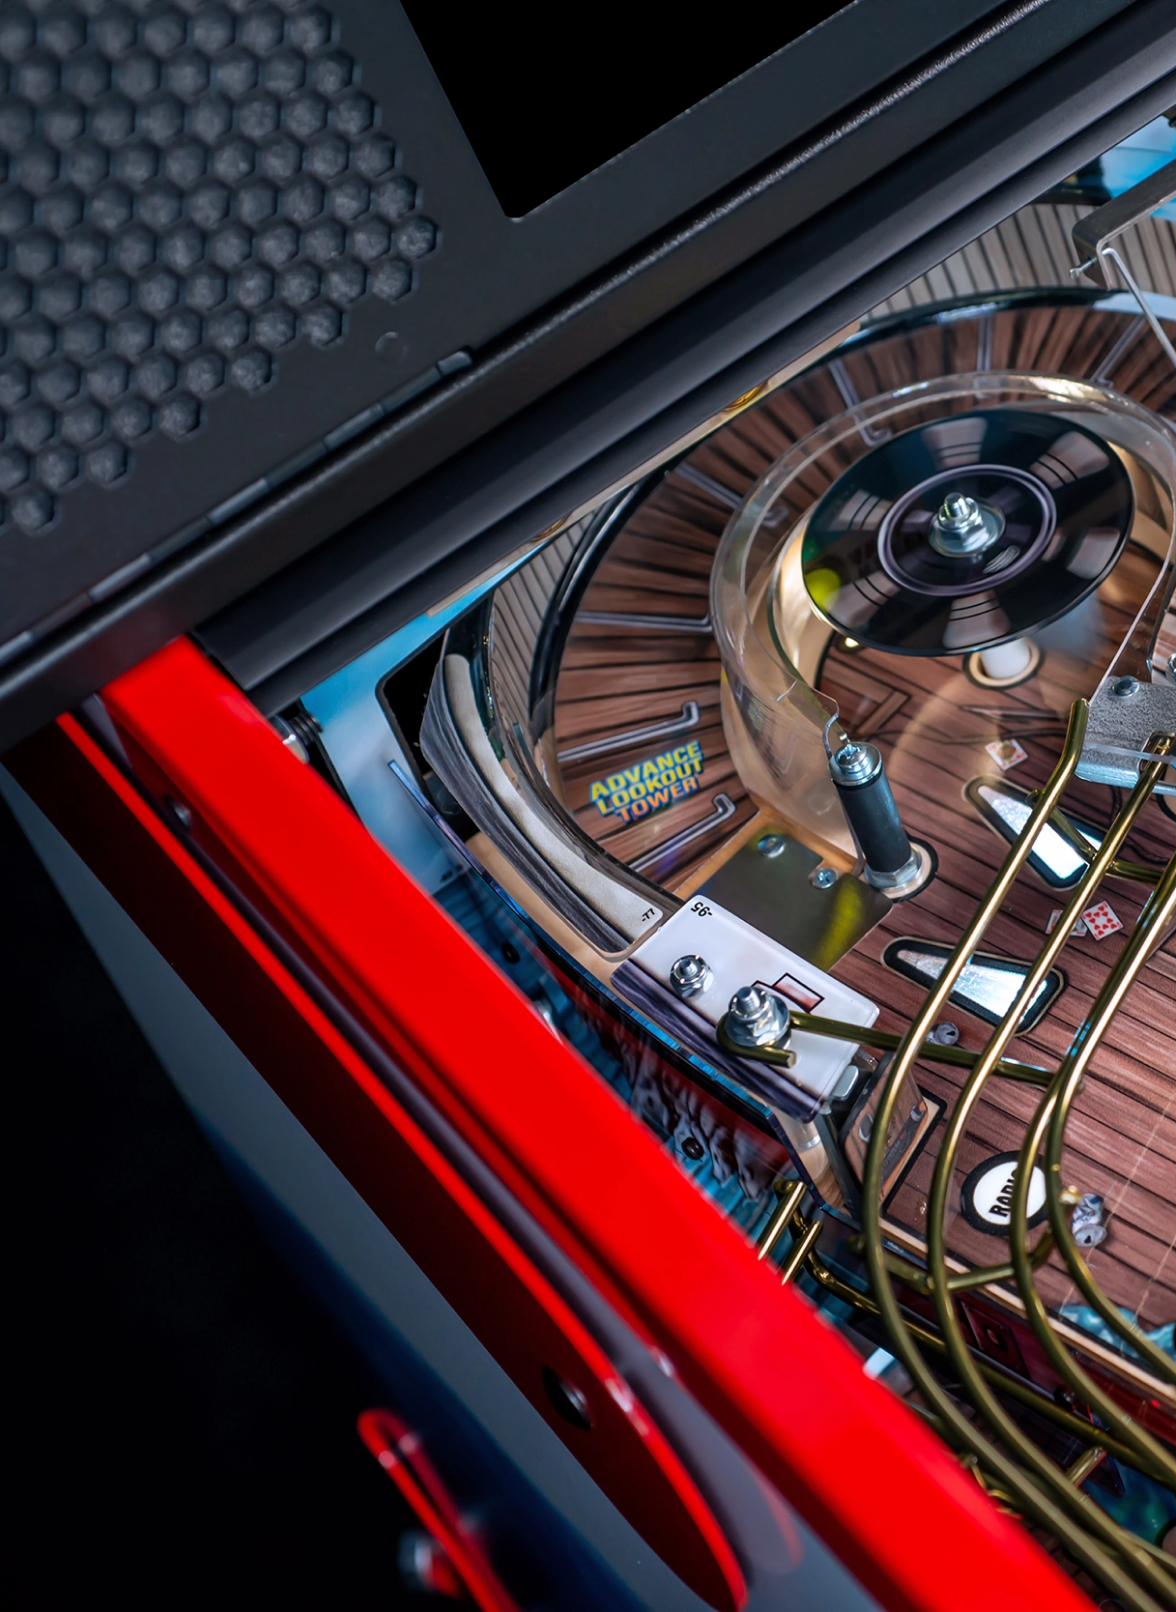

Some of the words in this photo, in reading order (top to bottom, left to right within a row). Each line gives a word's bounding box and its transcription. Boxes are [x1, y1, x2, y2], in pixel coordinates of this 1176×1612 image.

[590, 740, 702, 801] ADVANCE
[596, 757, 703, 816] LOOKOUT
[615, 776, 699, 822] TOWER
[641, 907, 656, 922] -77
[690, 901, 713, 918] -95
